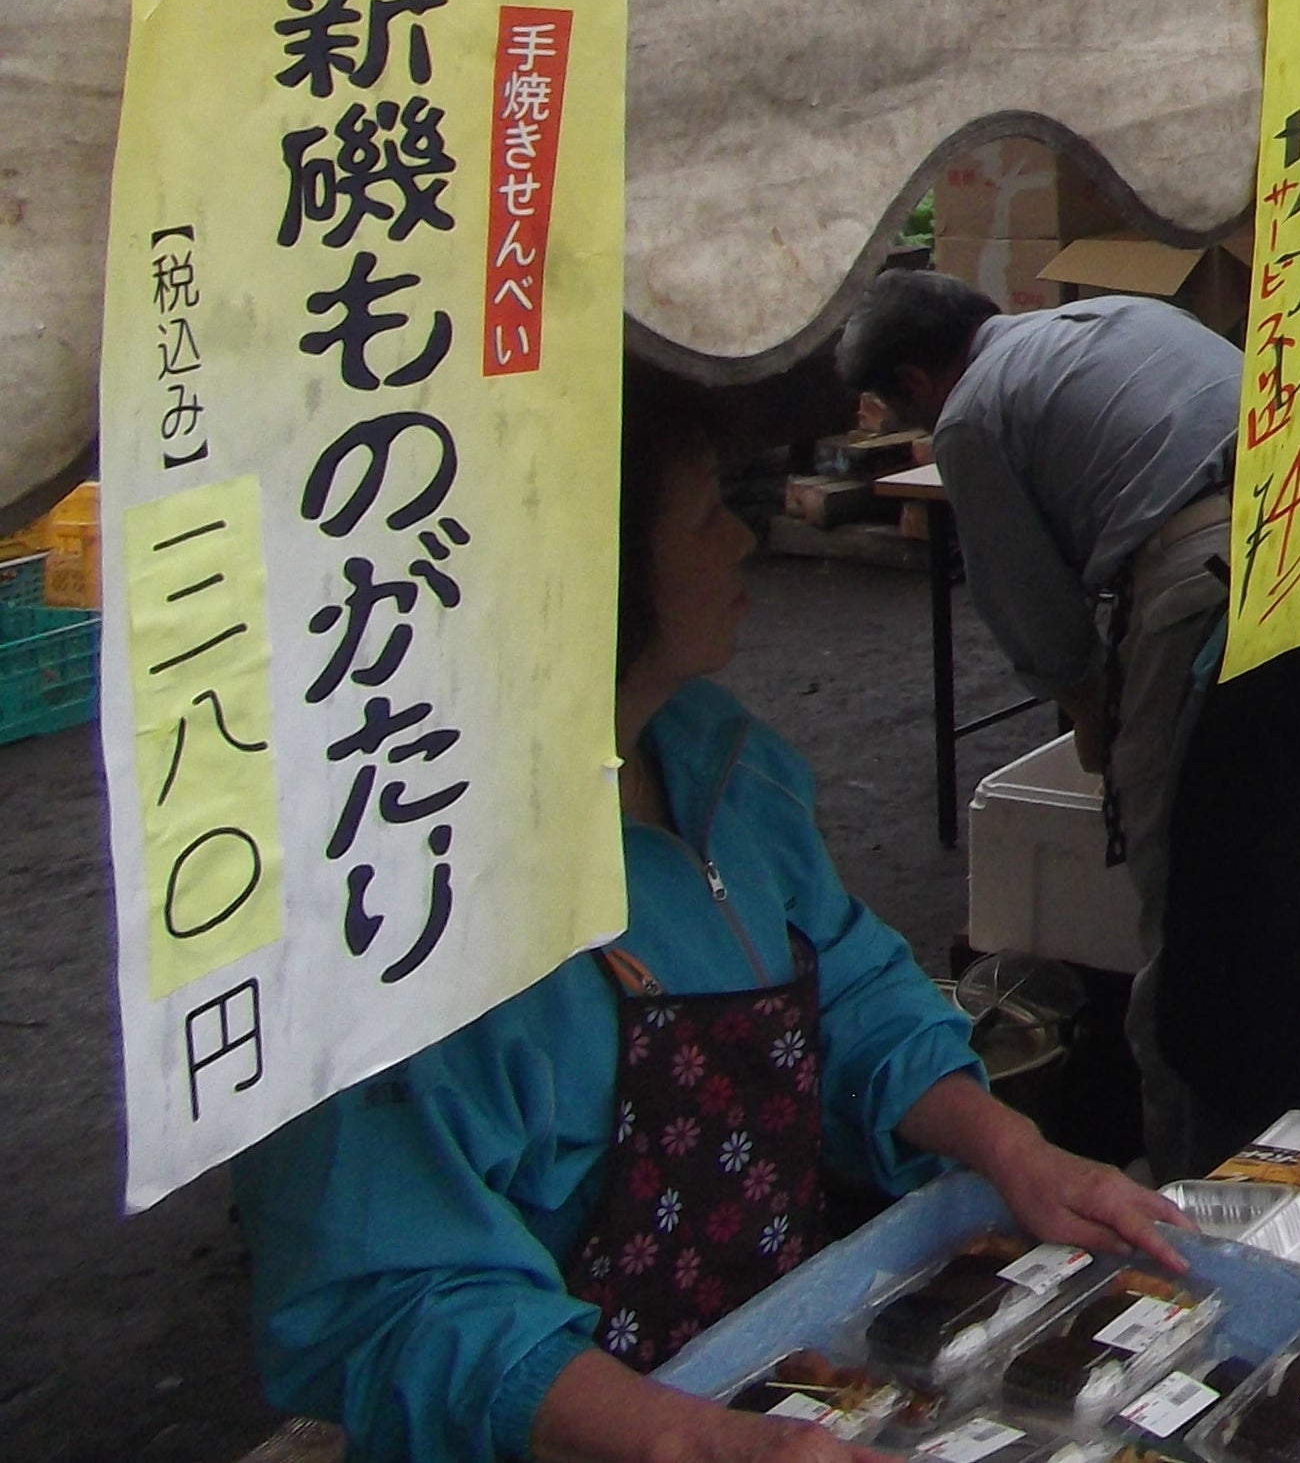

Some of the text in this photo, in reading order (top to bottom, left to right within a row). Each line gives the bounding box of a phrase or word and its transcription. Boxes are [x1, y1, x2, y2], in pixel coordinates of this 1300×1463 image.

[493, 22, 557, 366] 手焼きせんべい
